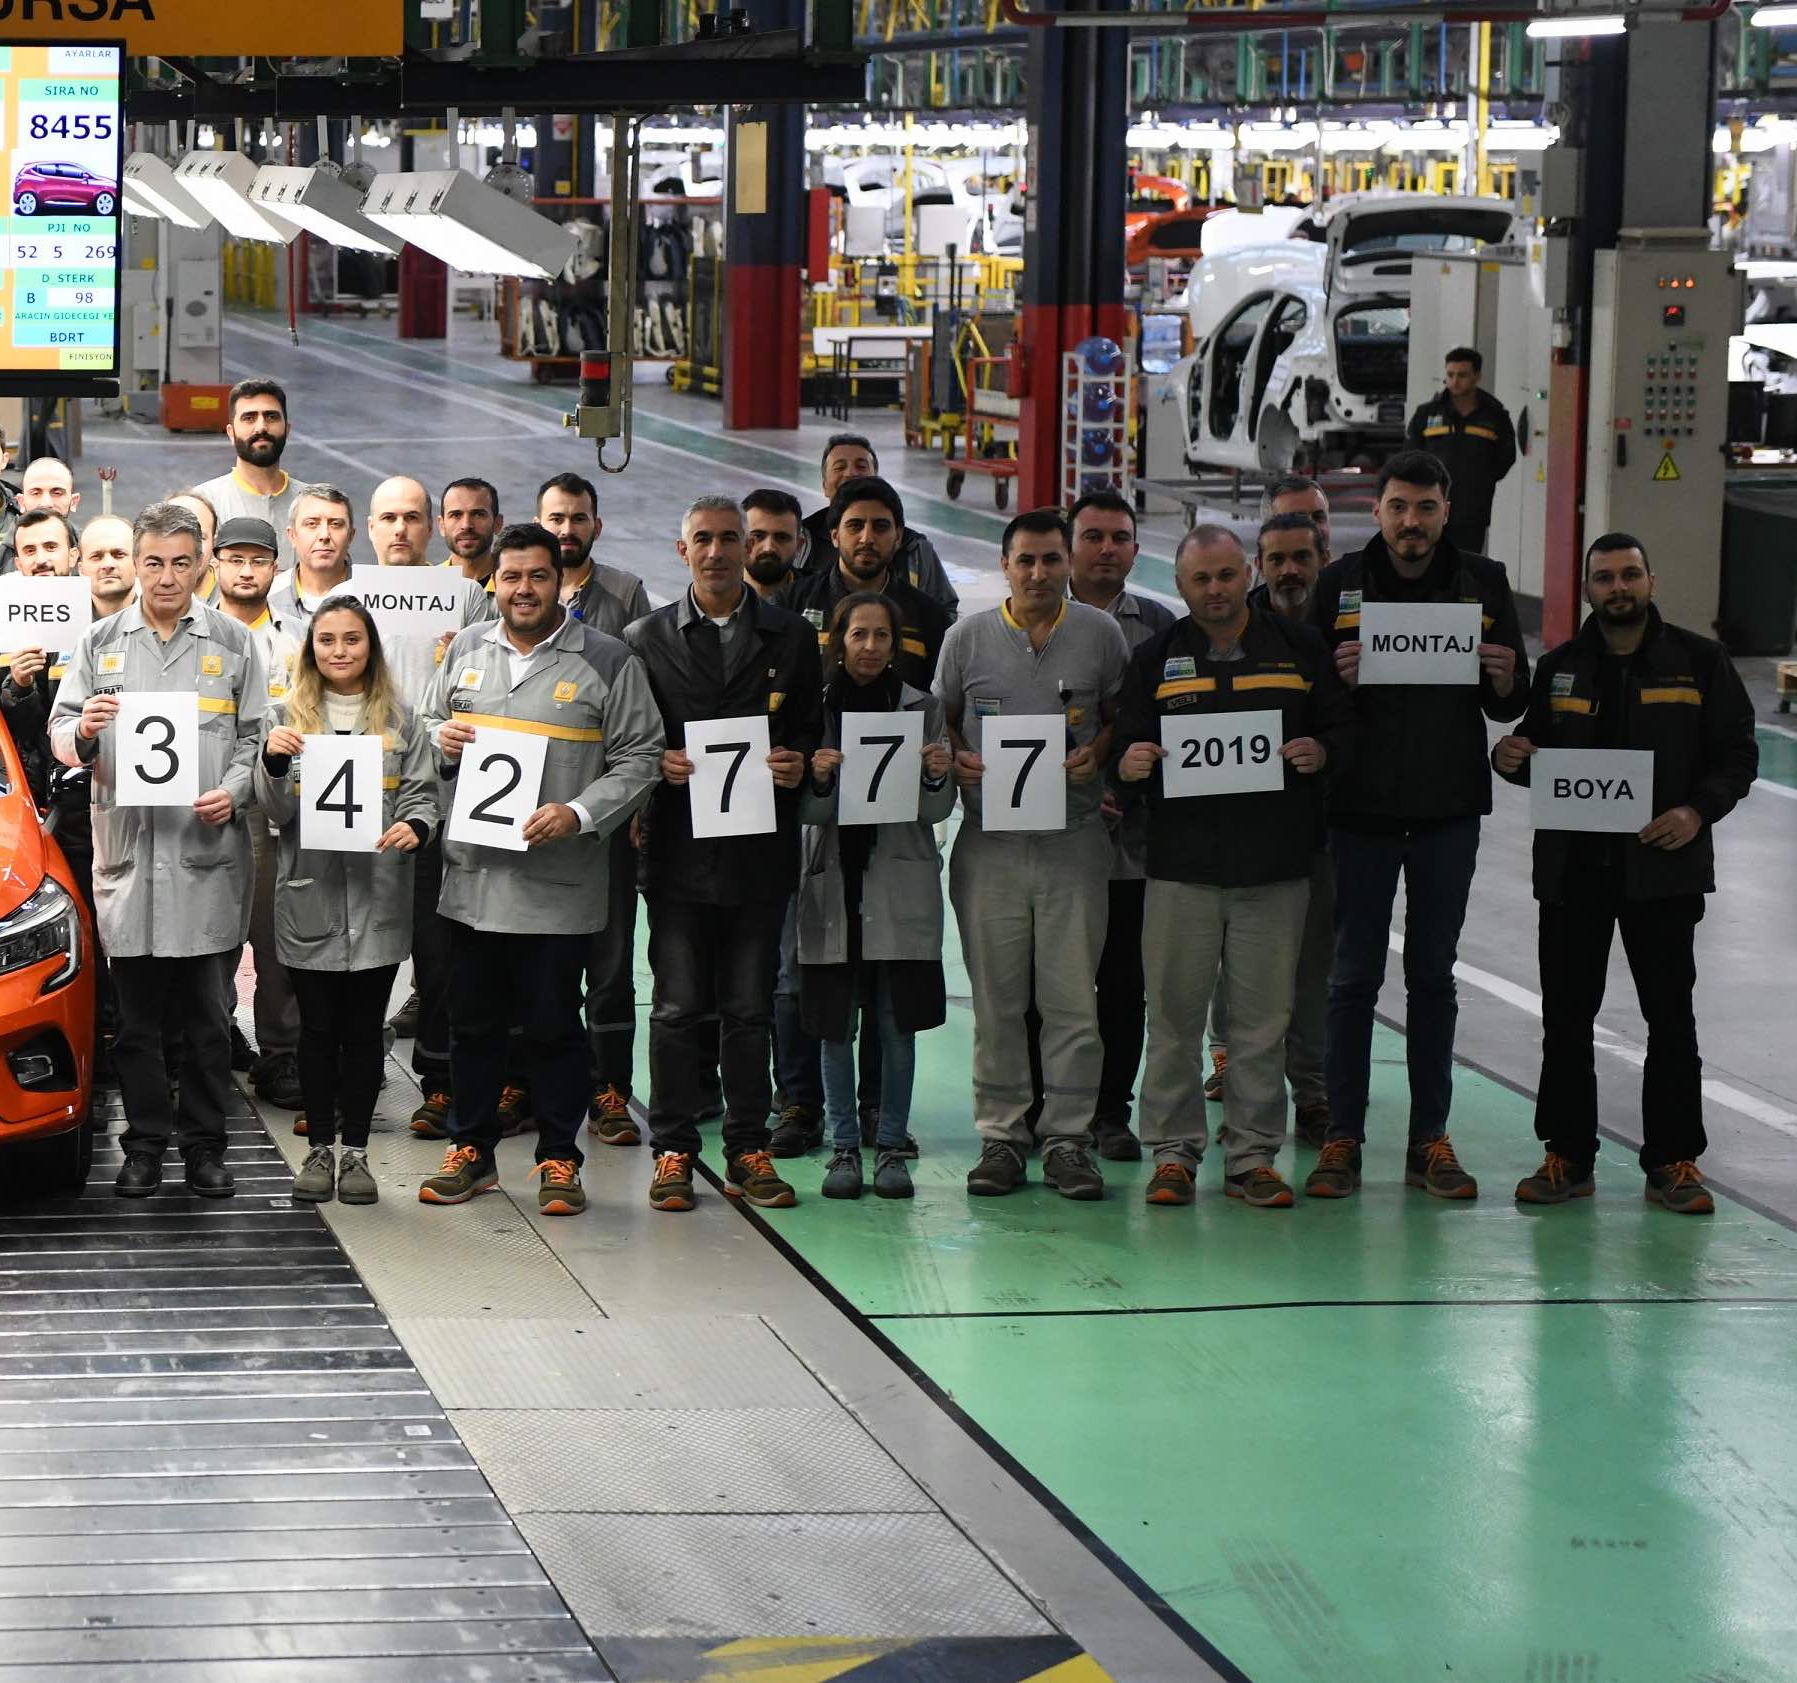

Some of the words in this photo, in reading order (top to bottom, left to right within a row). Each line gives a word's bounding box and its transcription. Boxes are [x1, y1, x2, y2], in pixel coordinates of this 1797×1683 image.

[65, 49, 112, 58] AYARLAR
[45, 86, 75, 96] SIRA
[80, 86, 99, 96] NO
[30, 114, 112, 139] 8455
[48, 223, 65, 232] PJI
[73, 223, 91, 232] NO
[17, 246, 37, 258] 52
[53, 246, 63, 258] 5
[85, 246, 115, 258] 269
[42, 274, 95, 285] D_STERK
[27, 292, 35, 304] B
[75, 292, 93, 304] 98
[50, 333, 85, 342] BDRT
[363, 594, 455, 611] MONTAJ
[8, 604, 71, 623] PRES
[1372, 634, 1474, 654] MONTAJ
[134, 715, 180, 785] 3
[1181, 734, 1271, 769] 2019
[705, 741, 751, 814] 7
[859, 735, 905, 803] 7
[1000, 739, 1047, 809] 7
[315, 759, 363, 829] 4
[468, 753, 523, 826] 2
[1553, 778, 1634, 801] BOYA
